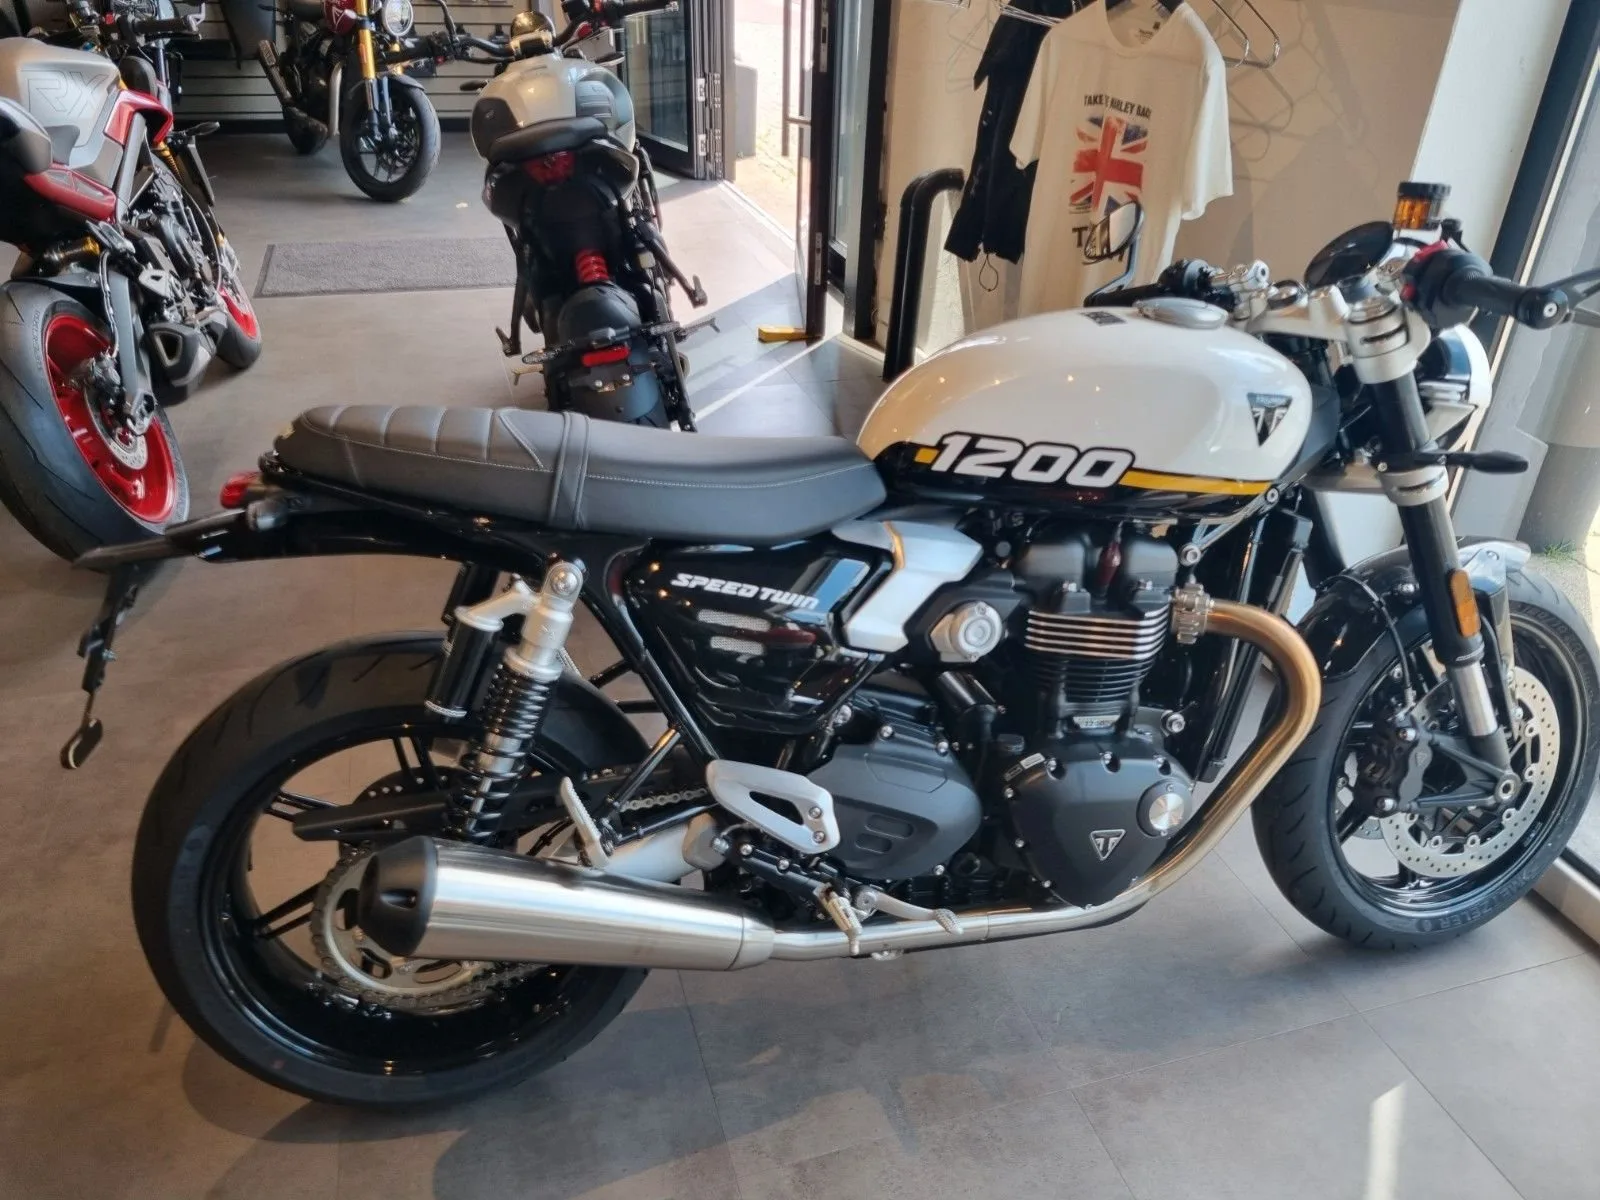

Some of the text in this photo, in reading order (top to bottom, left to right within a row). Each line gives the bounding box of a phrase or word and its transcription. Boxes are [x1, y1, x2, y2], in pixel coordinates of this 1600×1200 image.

[1083, 94, 1103, 106] TAKE
[930, 432, 1135, 488] 1200
[670, 572, 760, 598] SPEED
